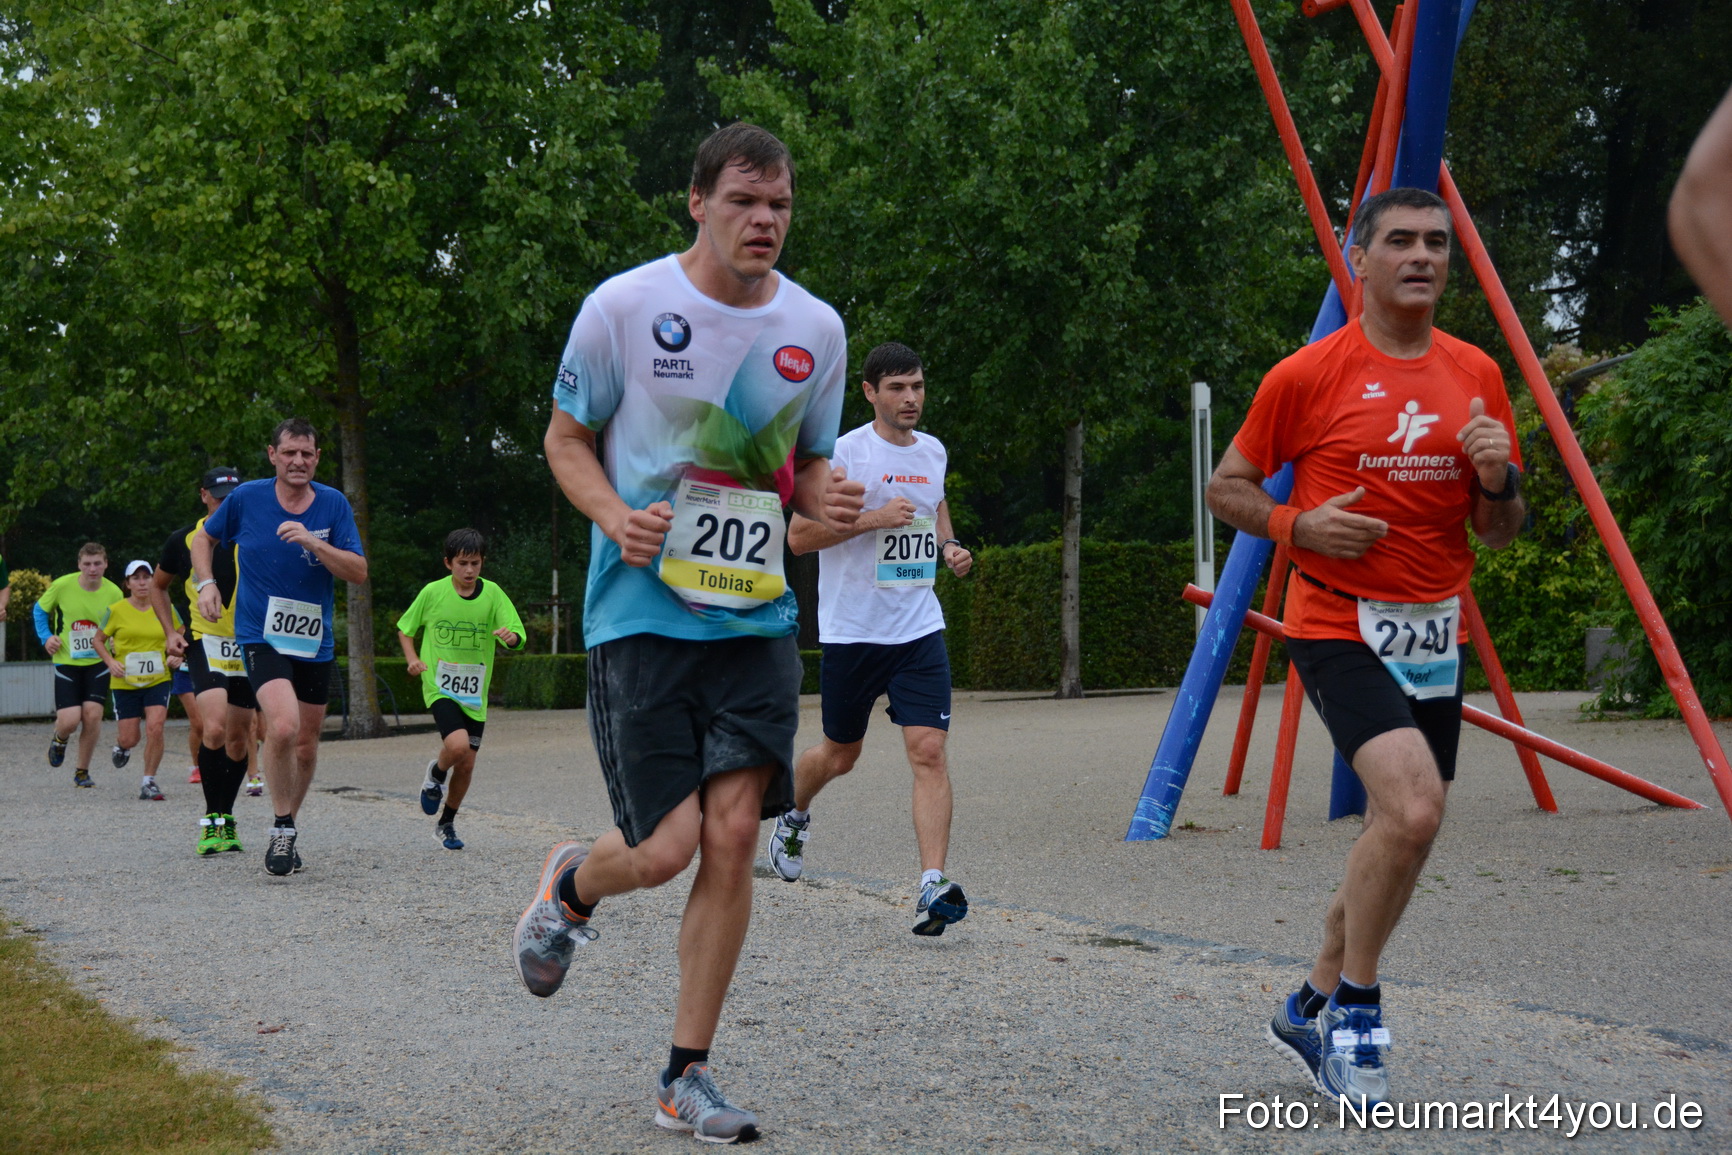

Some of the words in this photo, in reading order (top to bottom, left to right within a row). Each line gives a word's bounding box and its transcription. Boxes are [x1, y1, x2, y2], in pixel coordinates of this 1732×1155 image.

[655, 313, 688, 328] BMW
[653, 359, 694, 371] PARTL
[653, 370, 694, 380] Neumarkt
[1362, 391, 1386, 399] erima
[1357, 453, 1455, 471] funrunners
[895, 475, 931, 484] KLEBL
[1387, 467, 1461, 481] neumarkt
[685, 494, 721, 506] NeuerMarkt
[728, 492, 782, 513] BOCK
[691, 513, 771, 566] 202
[883, 532, 935, 561] 2076
[896, 567, 924, 579] Sergej
[698, 569, 754, 593] Tobias
[272, 611, 322, 637] 3020
[138, 660, 155, 674] 70
[441, 673, 480, 694] 2643
